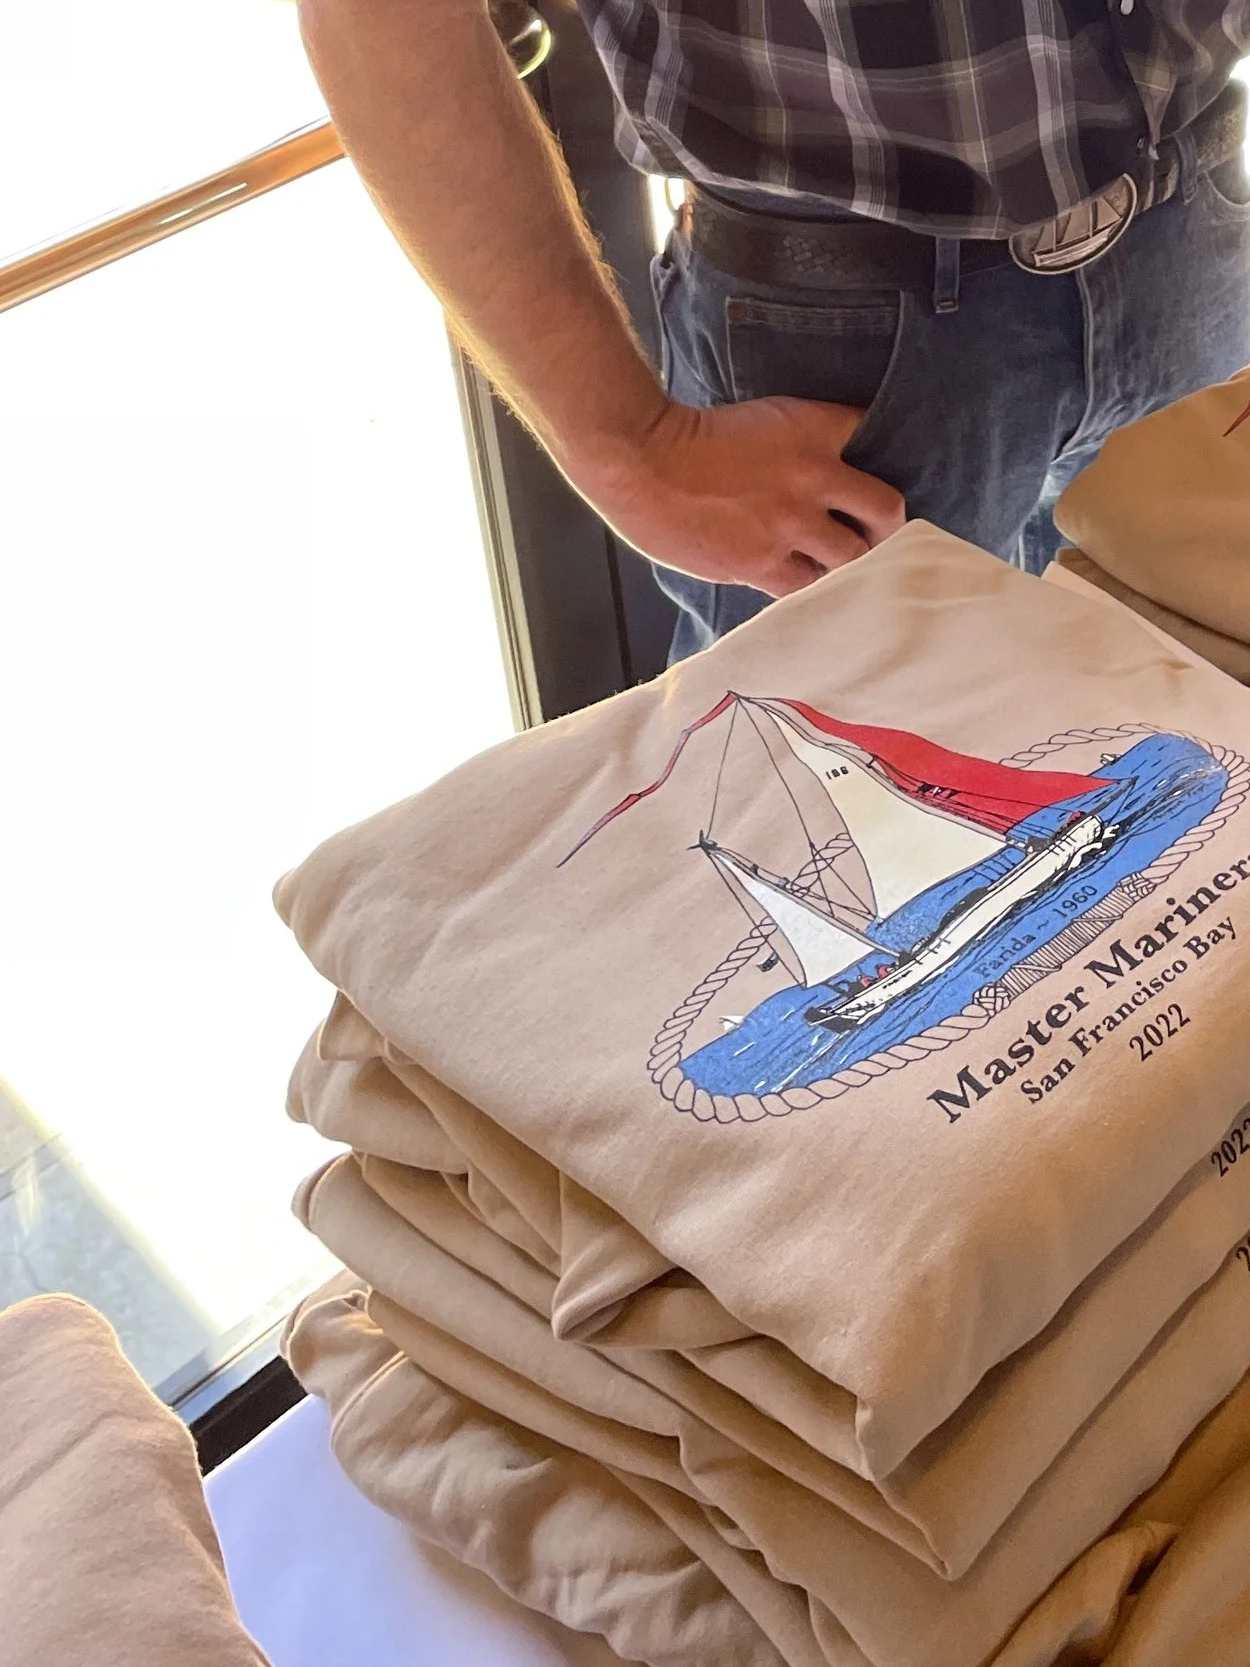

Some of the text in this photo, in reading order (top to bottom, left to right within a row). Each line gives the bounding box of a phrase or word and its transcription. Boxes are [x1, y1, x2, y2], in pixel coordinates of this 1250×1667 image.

[1052, 885, 1098, 918] 1960
[926, 985, 1091, 1124] Master
[1020, 915, 1238, 1105] San Francisco Bay
[1128, 1003, 1192, 1062] 2022
